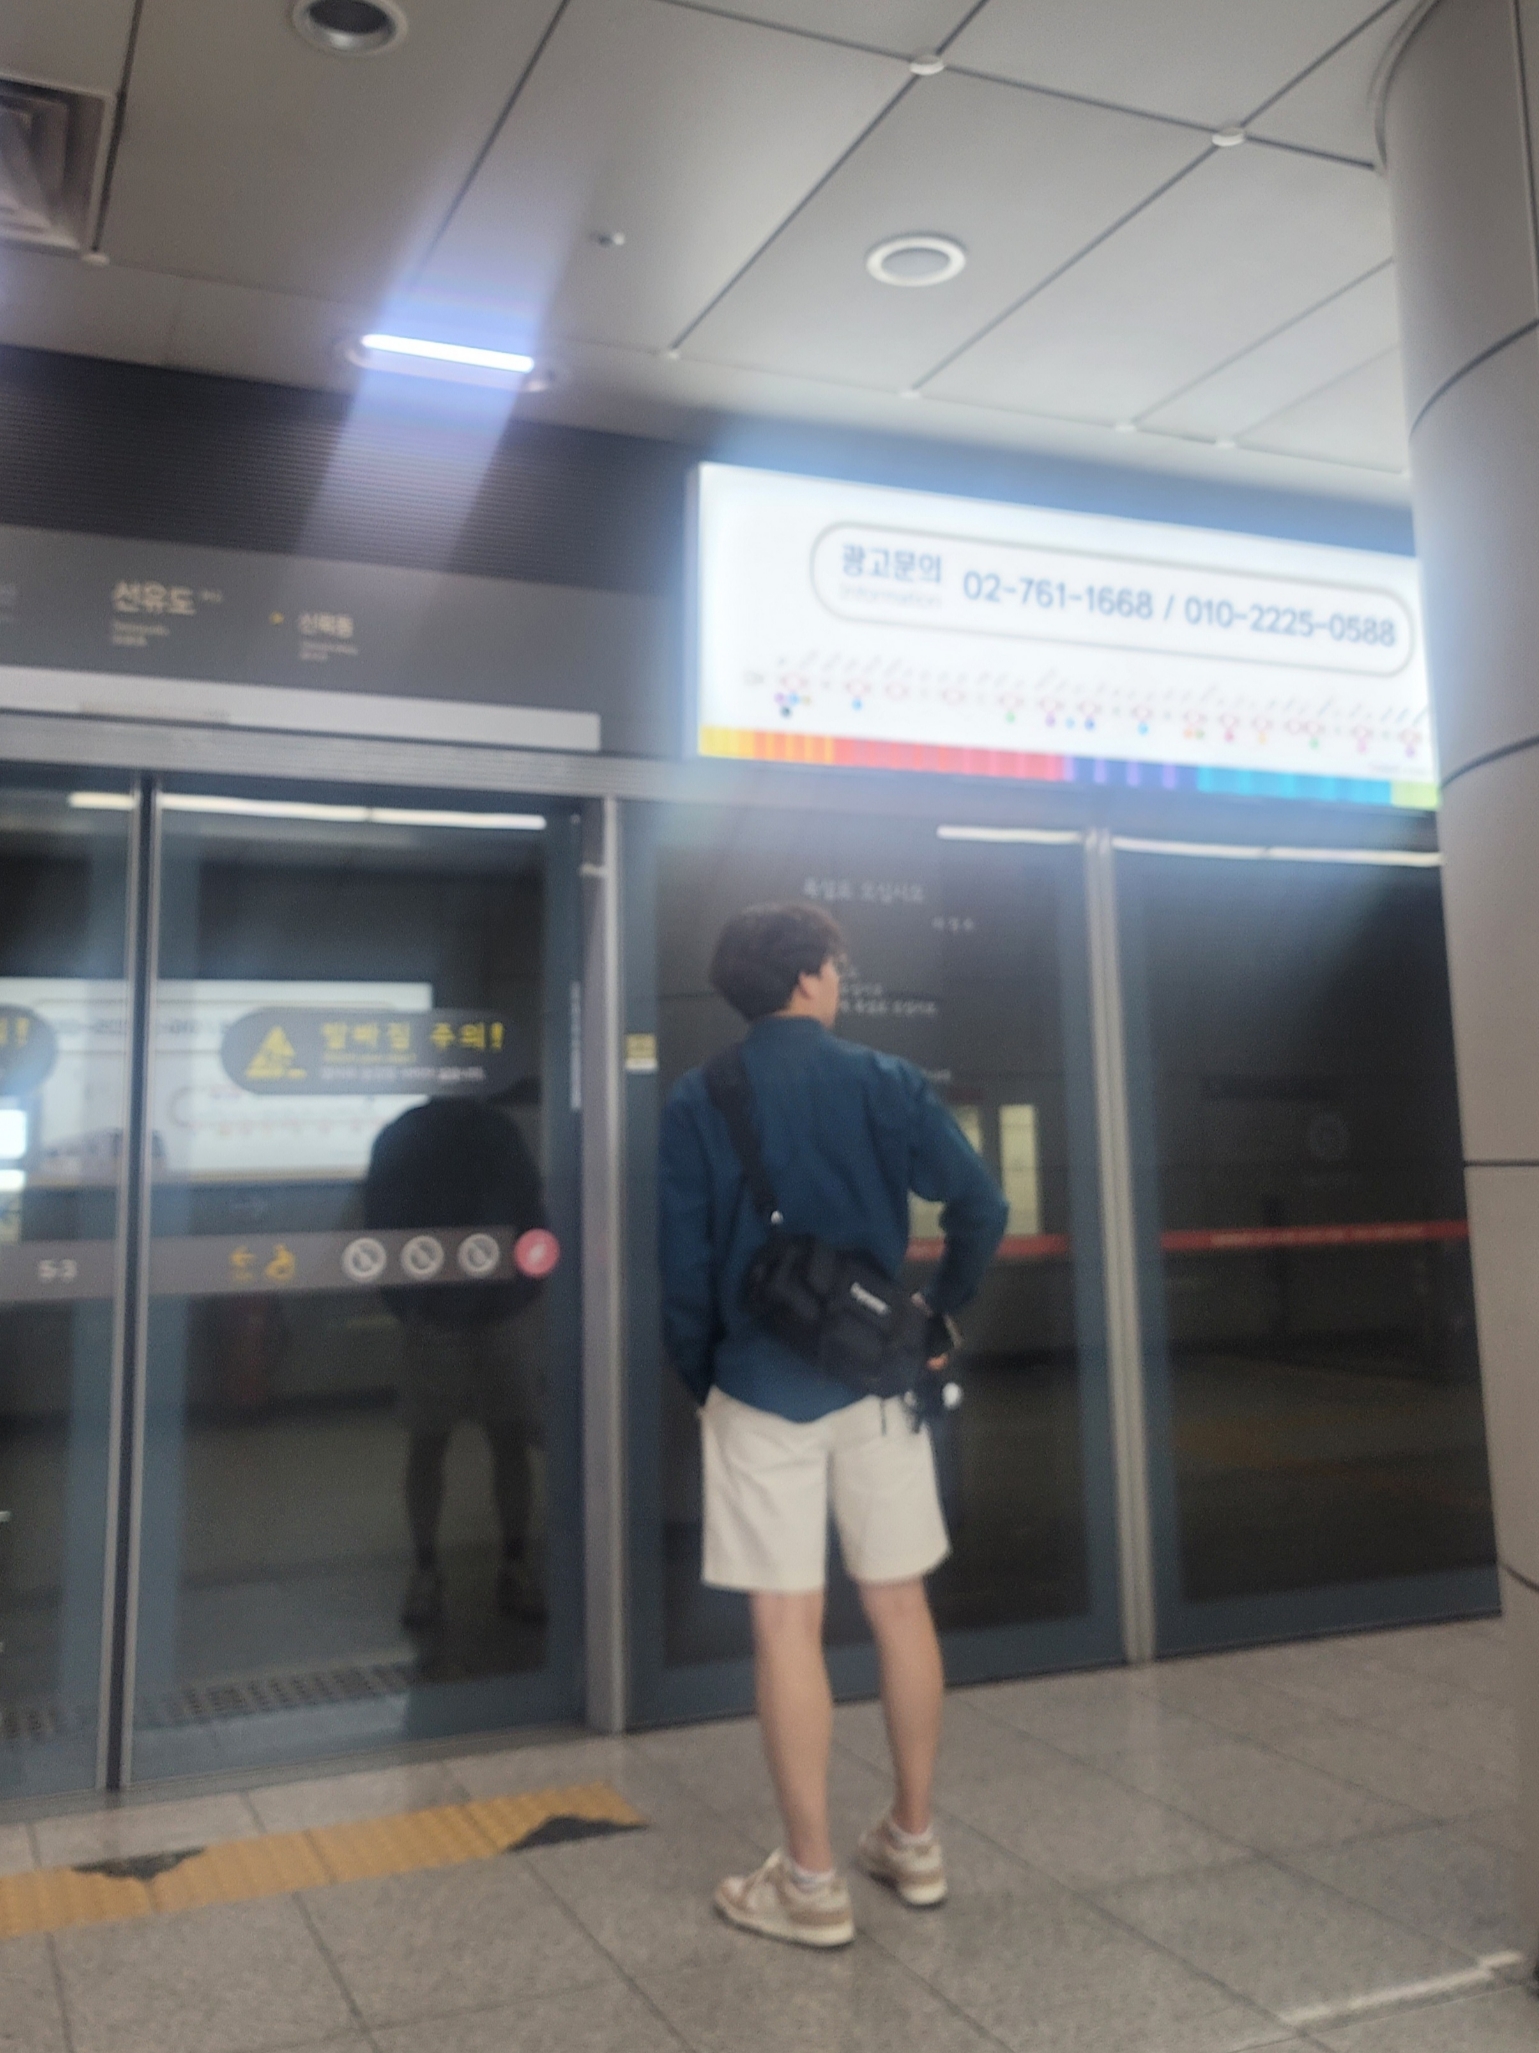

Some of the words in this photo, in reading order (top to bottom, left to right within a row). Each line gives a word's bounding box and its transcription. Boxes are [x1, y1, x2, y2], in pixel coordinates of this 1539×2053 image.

[841, 543, 942, 584] 광고문의
[114, 581, 196, 615] 선유도
[963, 570, 1152, 619] 02-761-1668
[1184, 595, 1397, 647] 010-2225-0588
[430, 1021, 506, 1052] 주의!
